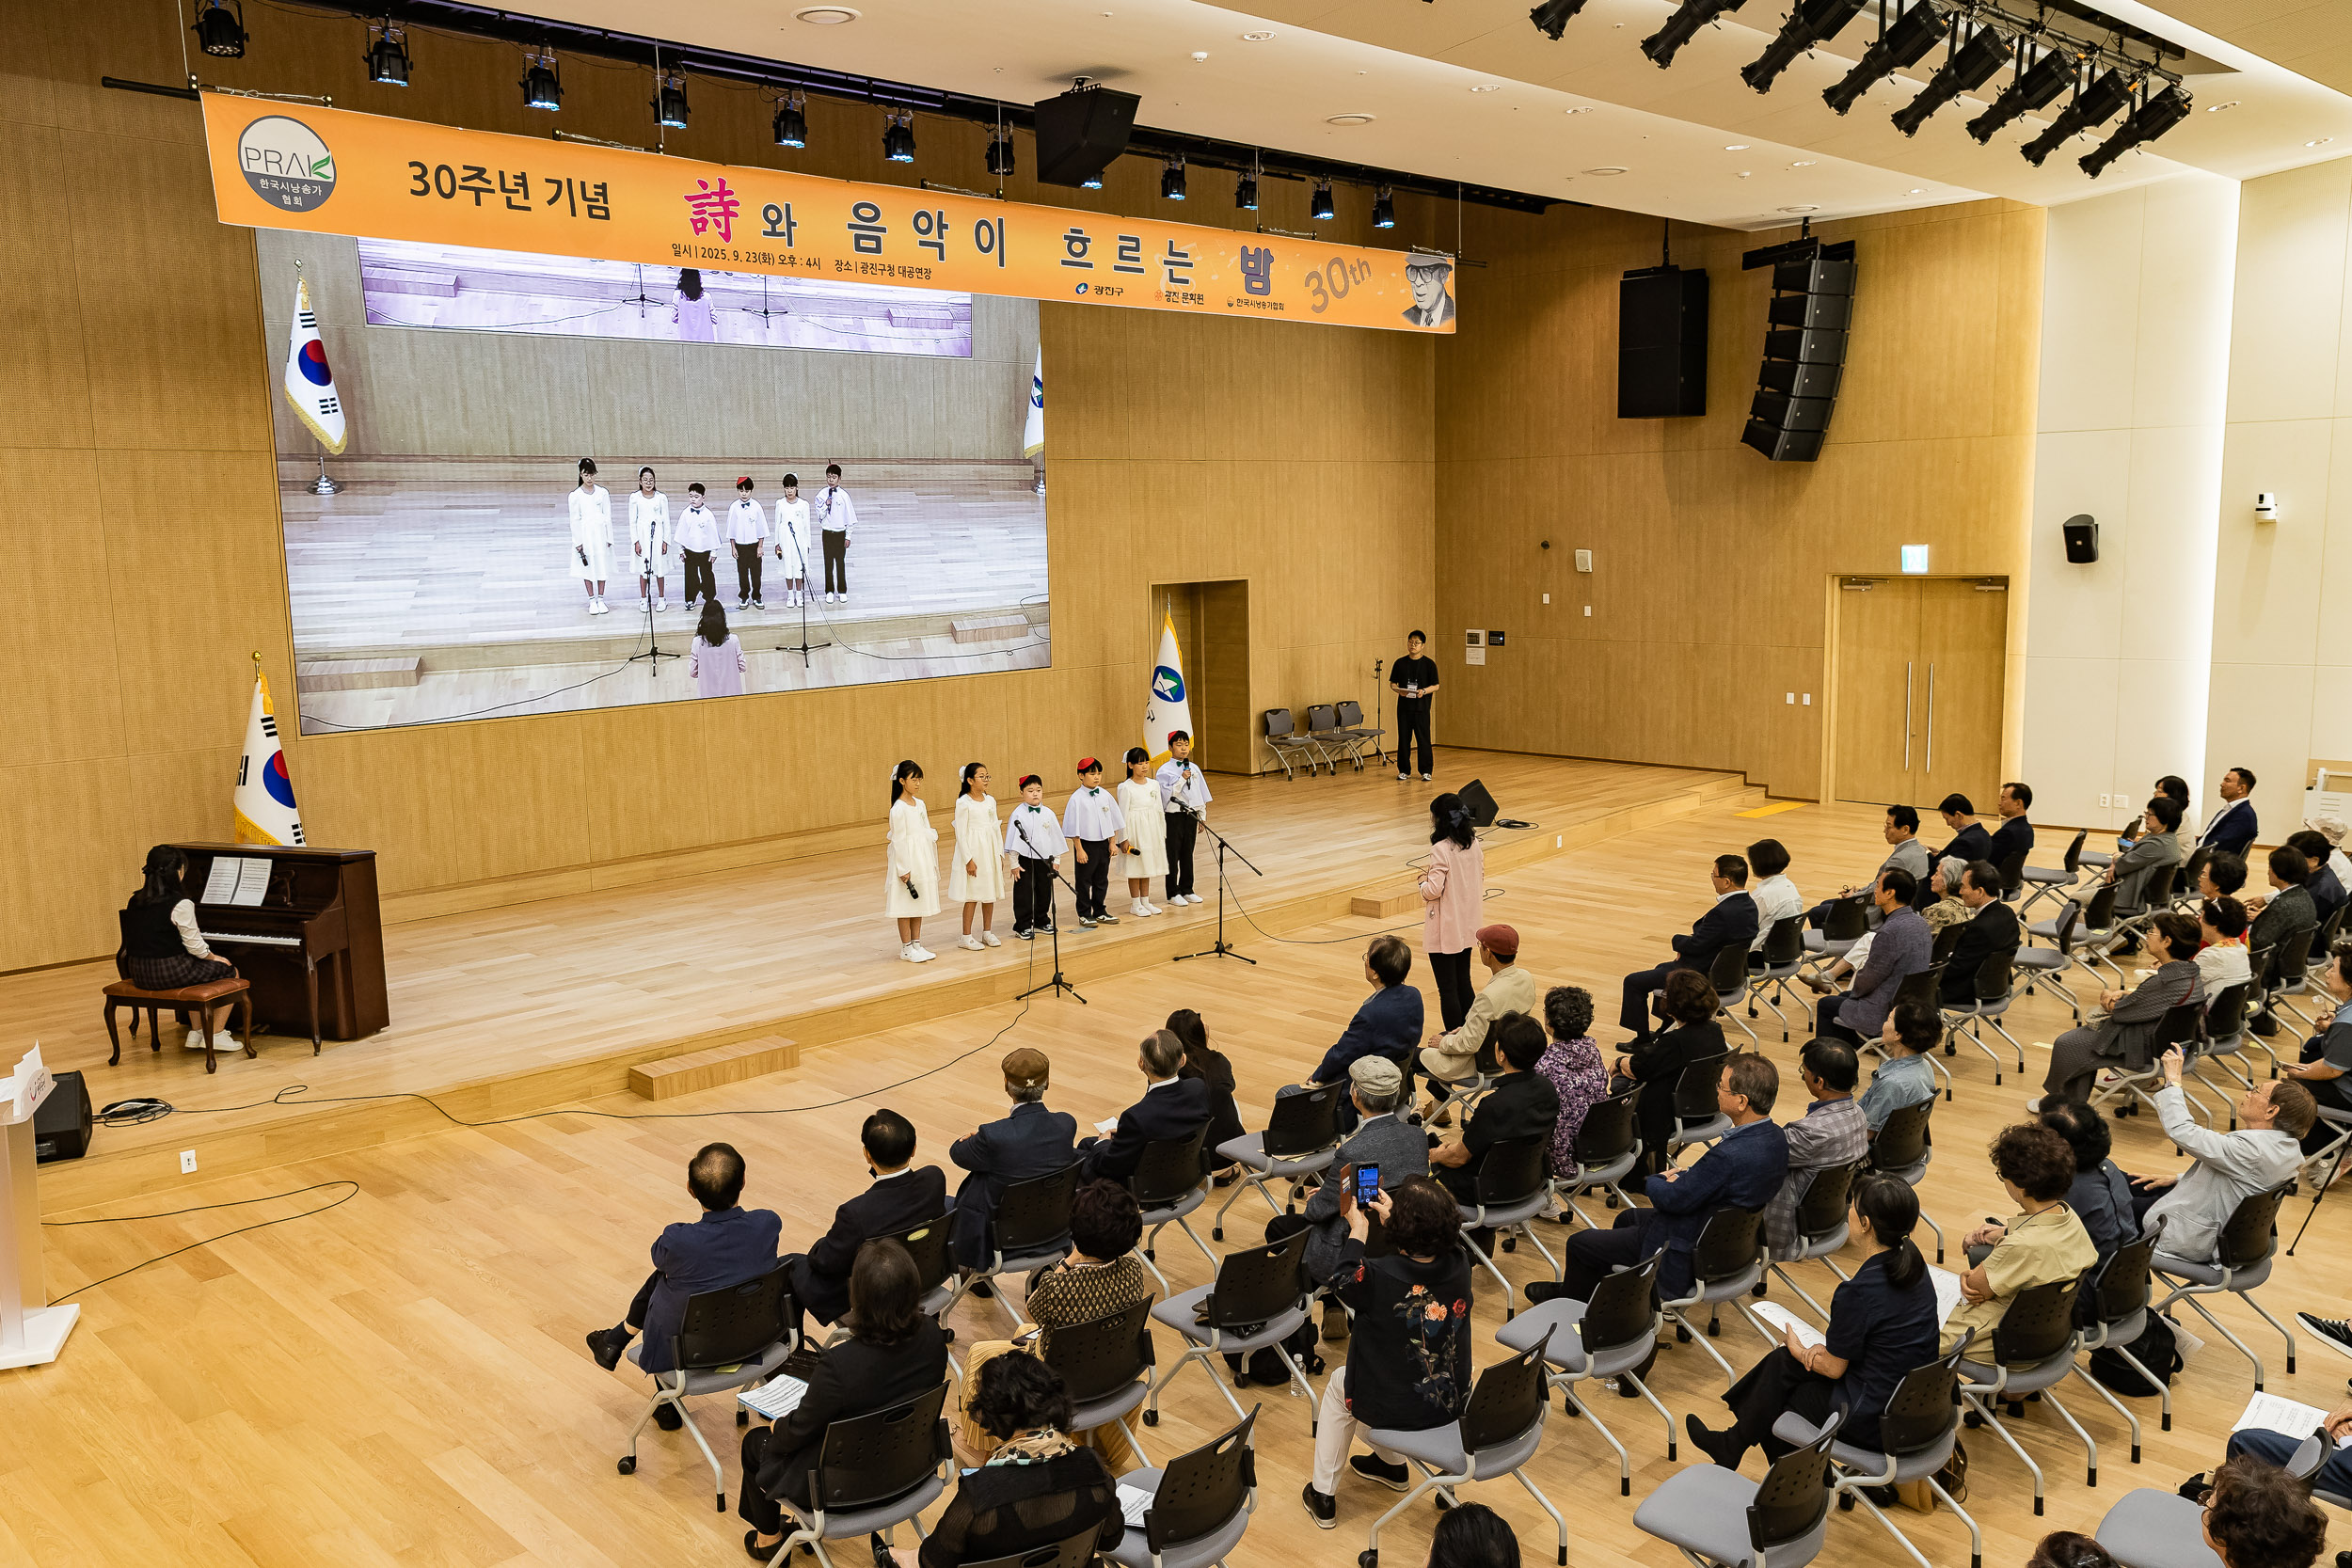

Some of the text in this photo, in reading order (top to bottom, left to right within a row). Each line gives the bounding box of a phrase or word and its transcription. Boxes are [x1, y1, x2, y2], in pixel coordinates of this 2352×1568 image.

[245, 146, 332, 180] PRAK
[259, 178, 323, 196] 한국시낭송가
[407, 160, 611, 221] 30주년 기념
[281, 194, 303, 207] 협회
[683, 177, 1275, 296] 詩와 음악이 흐르는 밤
[671, 243, 692, 258] 일시
[701, 246, 730, 261] 2025.
[733, 250, 743, 262] 9.
[746, 251, 775, 266] 23(화)
[778, 254, 798, 268] 오후
[805, 257, 821, 270] 4시
[834, 260, 853, 272] 장소
[860, 261, 896, 277] 광진구청
[898, 265, 932, 280] 대공연장
[1093, 285, 1124, 296] 광진구
[1304, 257, 1372, 313] 30th
[1164, 291, 1204, 305] 광진 문화원
[1236, 297, 1284, 310] 한국시낭송가협회
